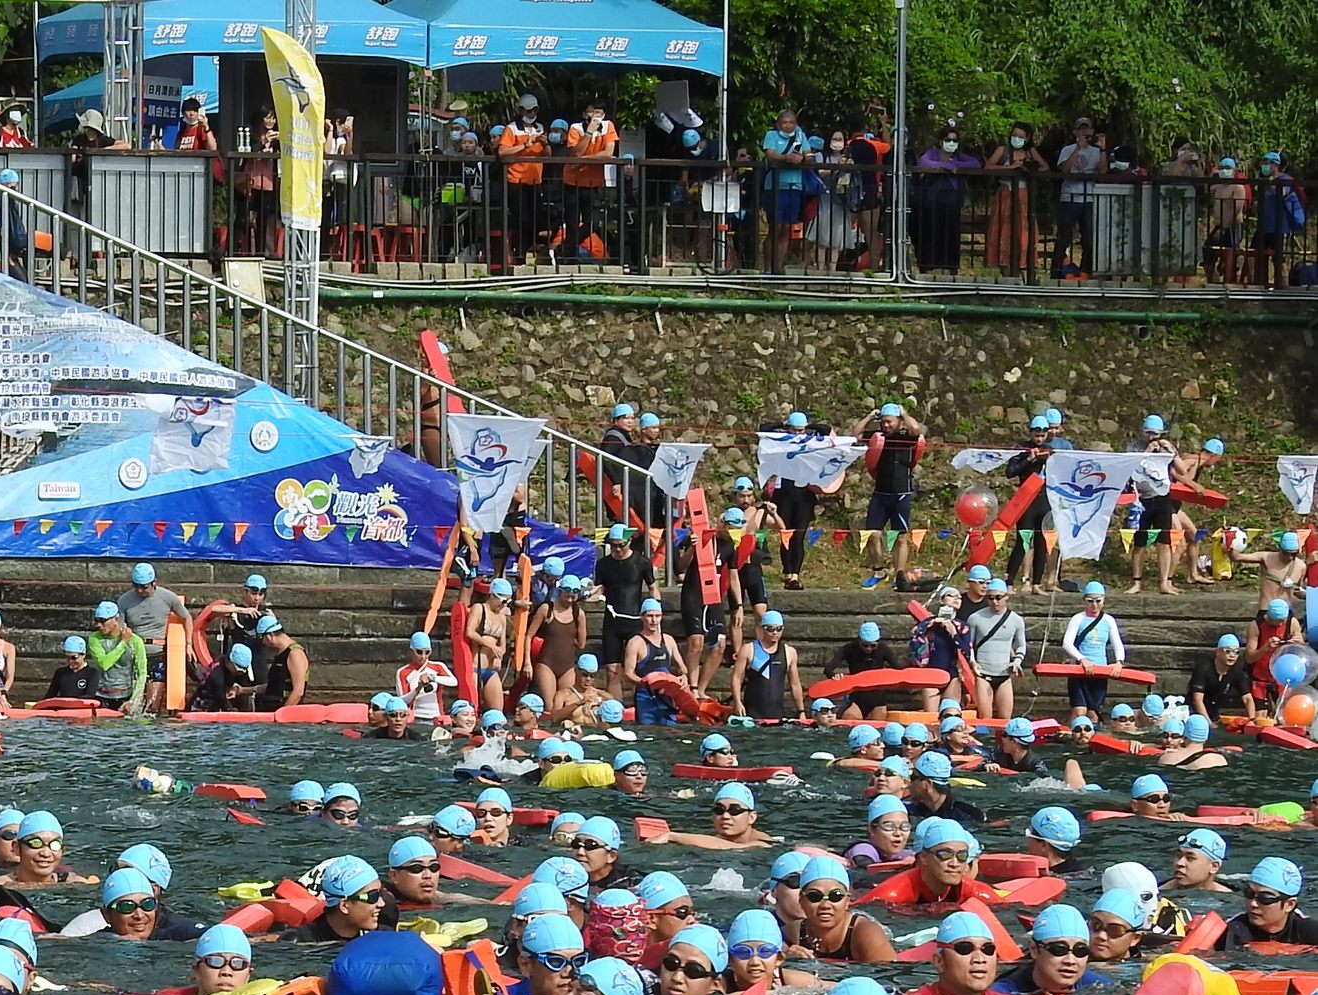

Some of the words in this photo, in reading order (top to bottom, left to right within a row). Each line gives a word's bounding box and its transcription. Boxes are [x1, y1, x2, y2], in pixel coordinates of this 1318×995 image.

[154, 24, 188, 38] 舒跑
[225, 23, 258, 37] 舒跑
[366, 27, 400, 41] 舒跑
[454, 35, 488, 49] 舒跑
[525, 35, 559, 49] 舒跑
[596, 37, 630, 51] 舒跑
[666, 40, 700, 54] 舒跑
[42, 484, 77, 493] Taiwan
